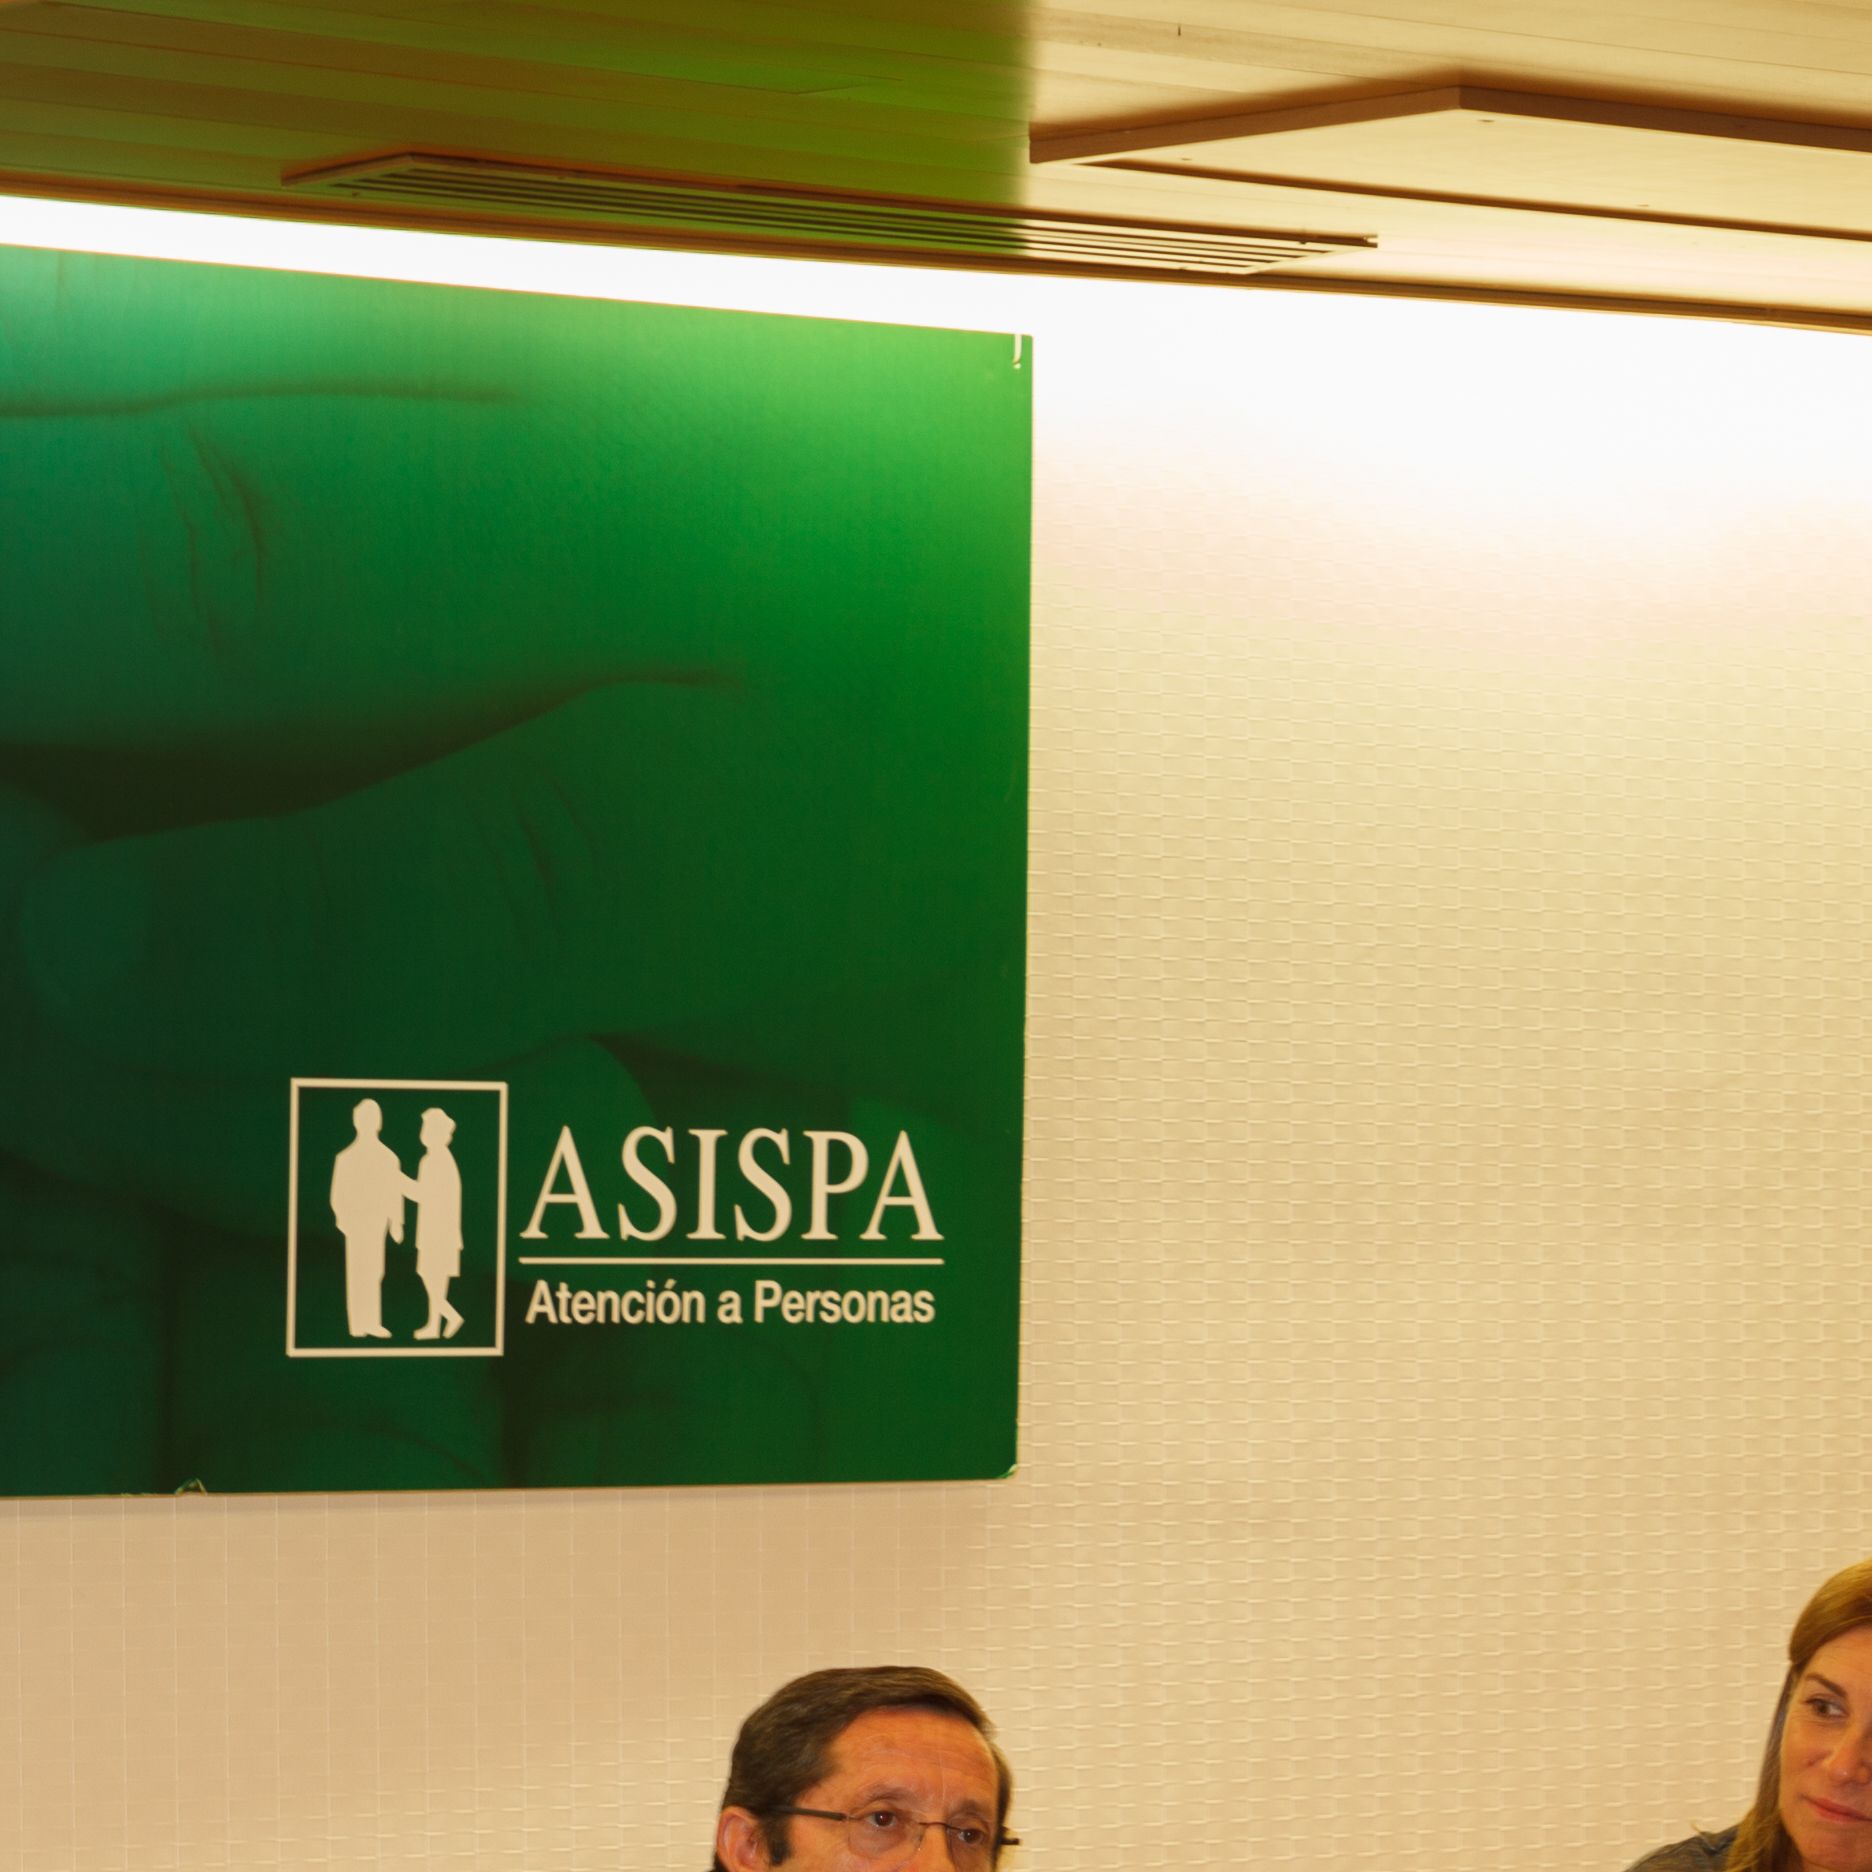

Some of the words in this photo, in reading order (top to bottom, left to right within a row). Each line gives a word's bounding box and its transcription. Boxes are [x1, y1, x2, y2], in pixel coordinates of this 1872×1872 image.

[519, 1125, 945, 1242] ASISPA
[525, 1278, 706, 1325] Atención
[717, 1290, 744, 1324] a
[754, 1279, 936, 1324] Personas
